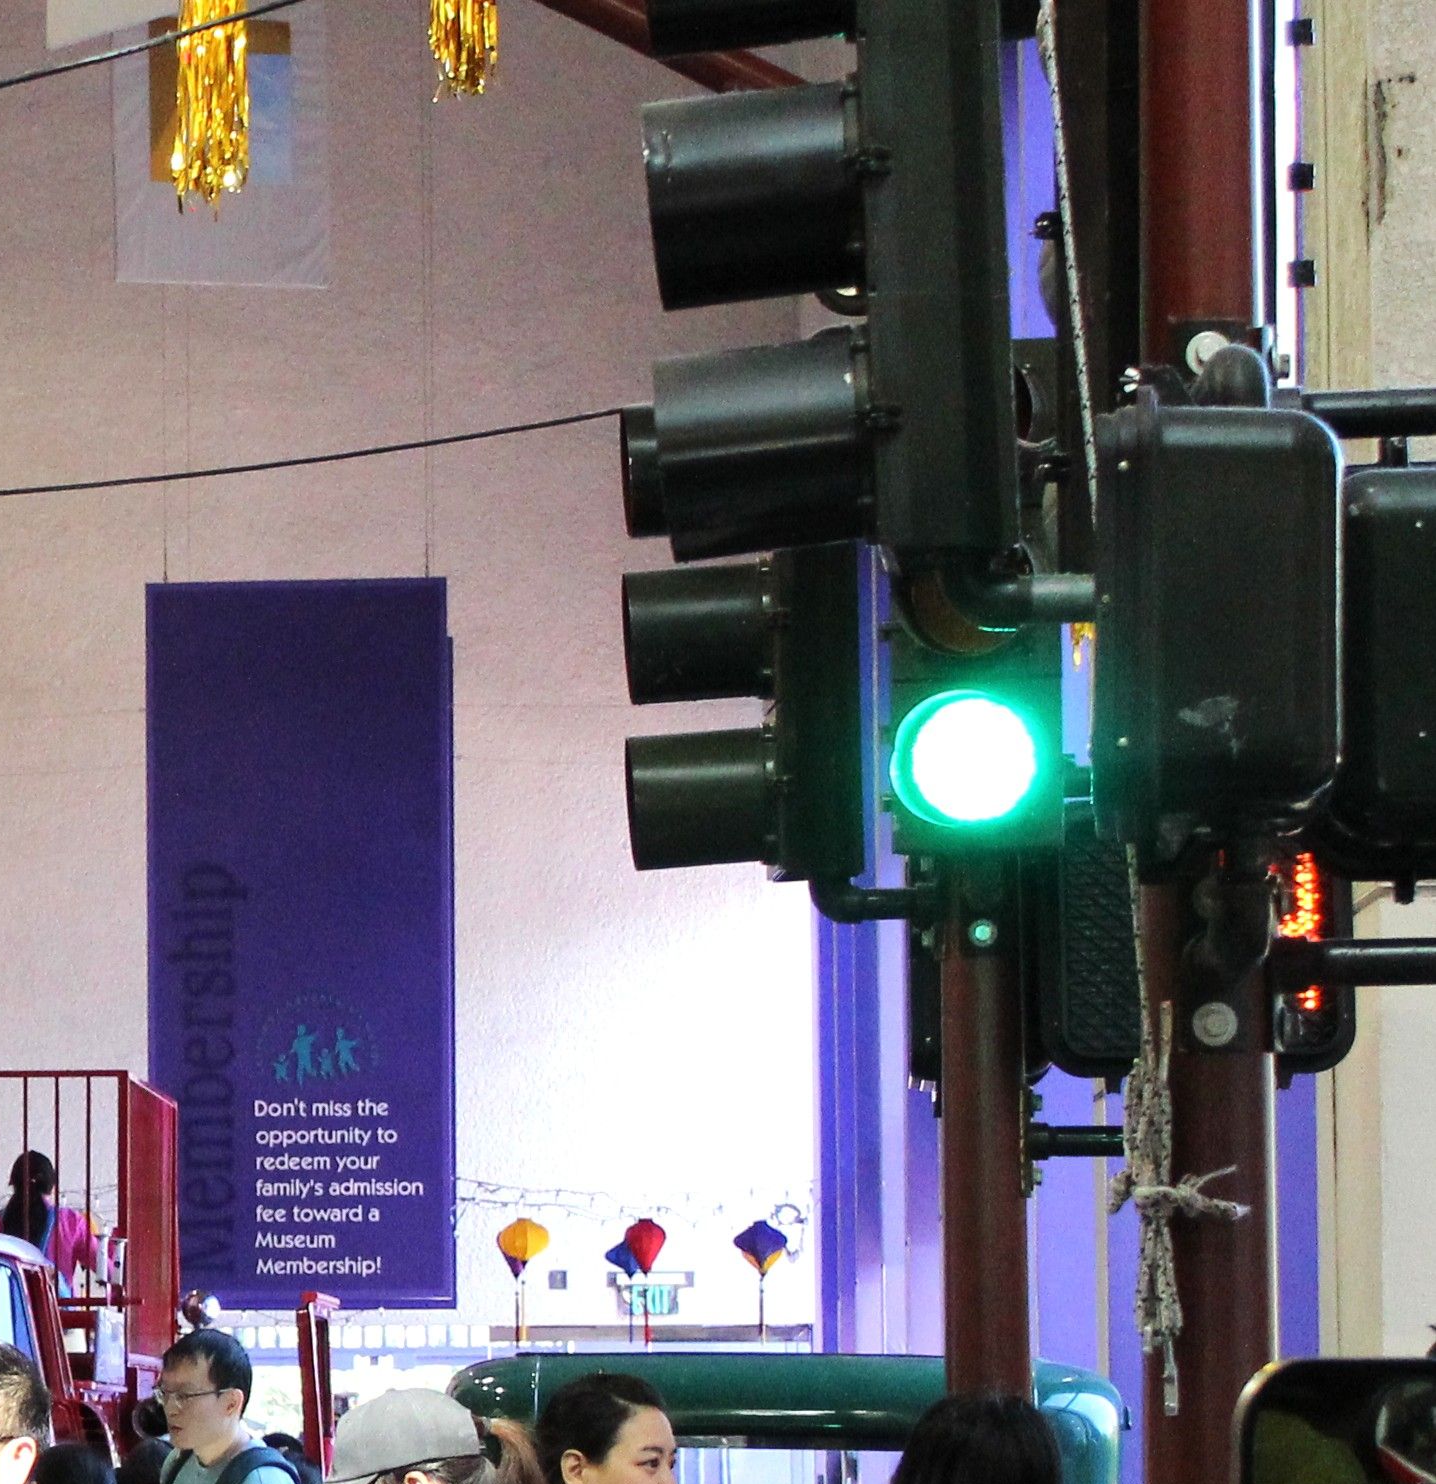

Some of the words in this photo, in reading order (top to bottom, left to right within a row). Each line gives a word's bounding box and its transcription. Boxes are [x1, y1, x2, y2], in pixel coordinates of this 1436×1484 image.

[253, 1098, 308, 1117] Don't
[311, 1099, 352, 1117] miss
[357, 1098, 389, 1117] the
[255, 1126, 372, 1148] opportunity
[377, 1126, 398, 1143] to
[255, 1153, 331, 1170] redeem
[335, 1154, 381, 1173] your
[255, 1178, 324, 1199] family's
[328, 1178, 425, 1196] admission
[255, 1204, 287, 1223] fee
[293, 1204, 363, 1222] toward
[368, 1208, 380, 1222] a
[254, 1231, 336, 1249] Museum
[255, 1256, 382, 1278] Membership!
